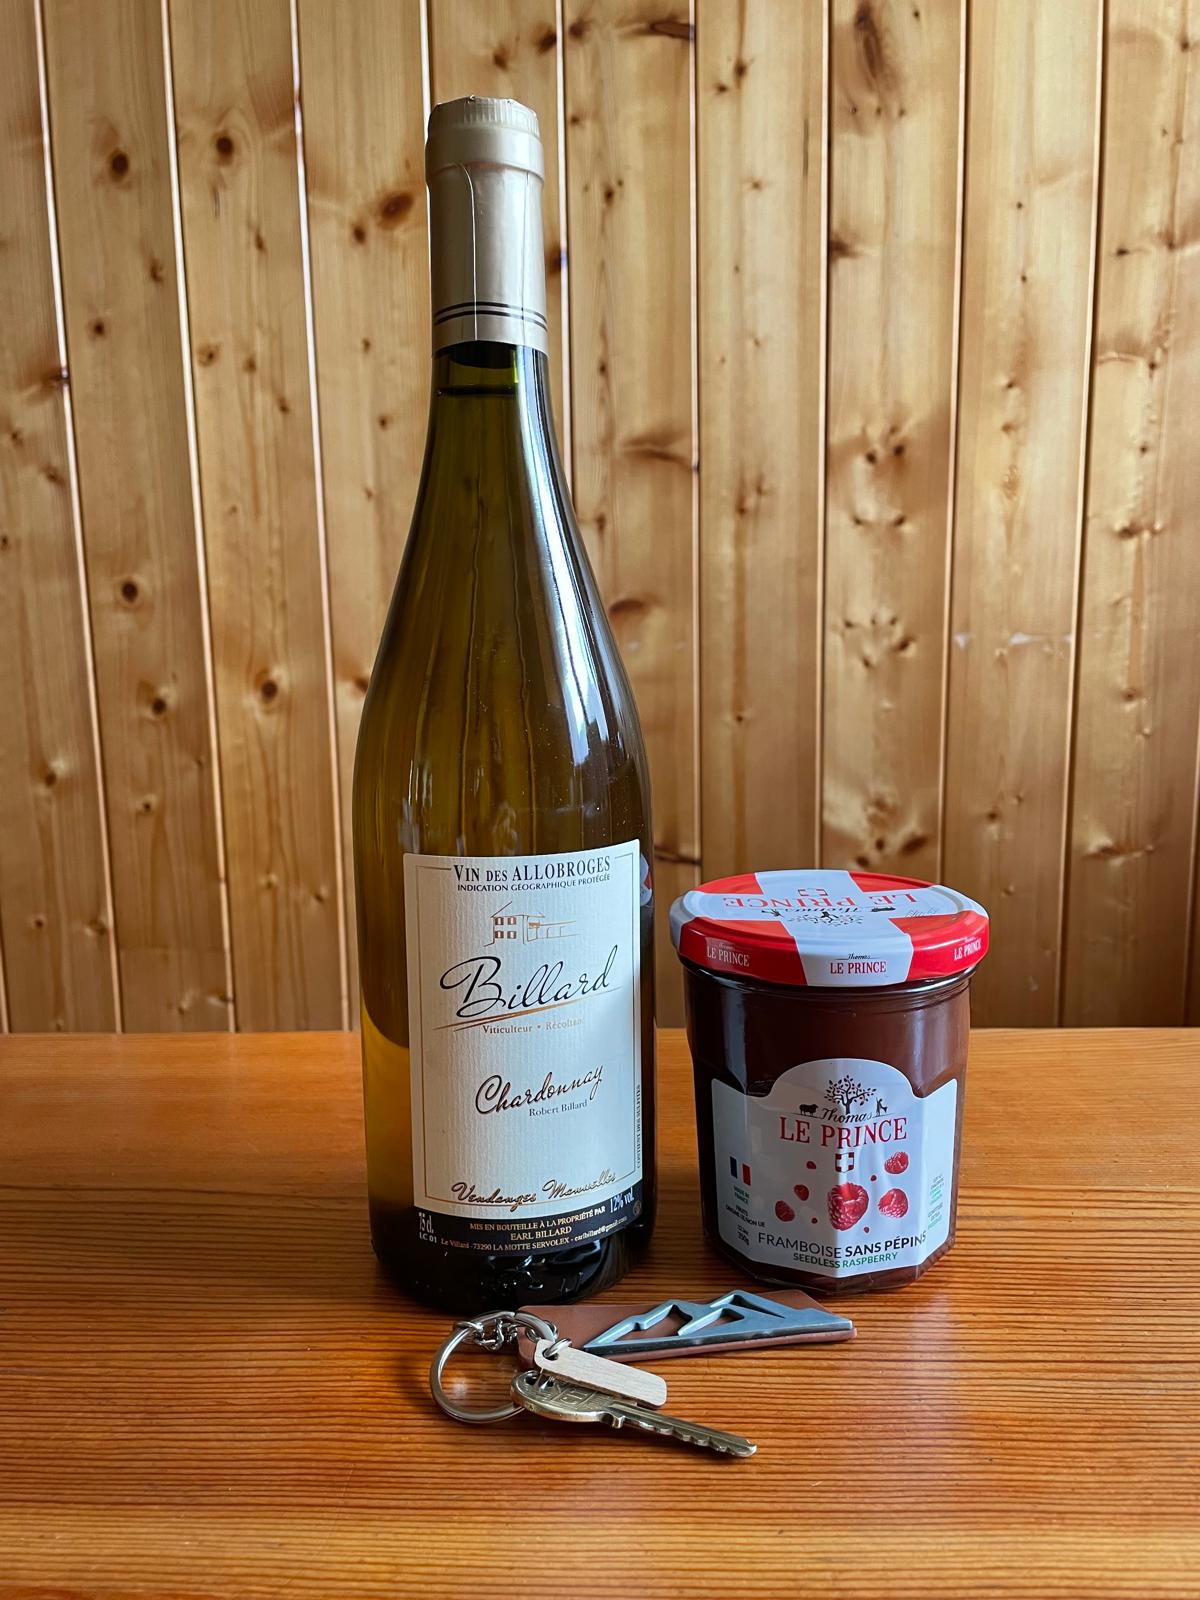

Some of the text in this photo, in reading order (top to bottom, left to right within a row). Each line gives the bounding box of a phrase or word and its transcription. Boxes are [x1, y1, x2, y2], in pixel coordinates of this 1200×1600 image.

[454, 856, 610, 882] VIN DES ALLOBROGES
[457, 873, 610, 892] INDICATION GÉOGRAPHIQUE PROTÉGÉE
[723, 893, 917, 908] LE PRINCE
[706, 946, 750, 967] LE PRINCE
[847, 952, 871, 960] Thomas
[954, 938, 982, 960] LE PRINCE
[830, 961, 887, 974] LE PRINCE
[439, 944, 618, 1018] Billard
[482, 1018, 584, 1034] Viticulteur Récoltan
[475, 1065, 603, 1114] Chardonnay
[528, 1099, 588, 1117] Robert Billard
[821, 1107, 872, 1124] Thomas
[780, 1117, 907, 1150] LE PRINCE
[451, 1168, 616, 1212] Vendanges Manuelles
[496, 1222, 538, 1230] BOUTEILLE
[539, 1220, 546, 1228] À
[546, 1219, 557, 1228] LA
[558, 1210, 594, 1226] PROPRIÉTÉ
[594, 1206, 606, 1216] PAR
[510, 1226, 572, 1241] EARL BILLARD
[504, 1242, 531, 1251] MOTTE
[532, 1236, 570, 1250] SERVOLEX
[758, 1230, 927, 1259] FRAMBOISE SANS PÉPINS
[793, 1252, 898, 1269] SEEDLESS RASPBERRY
